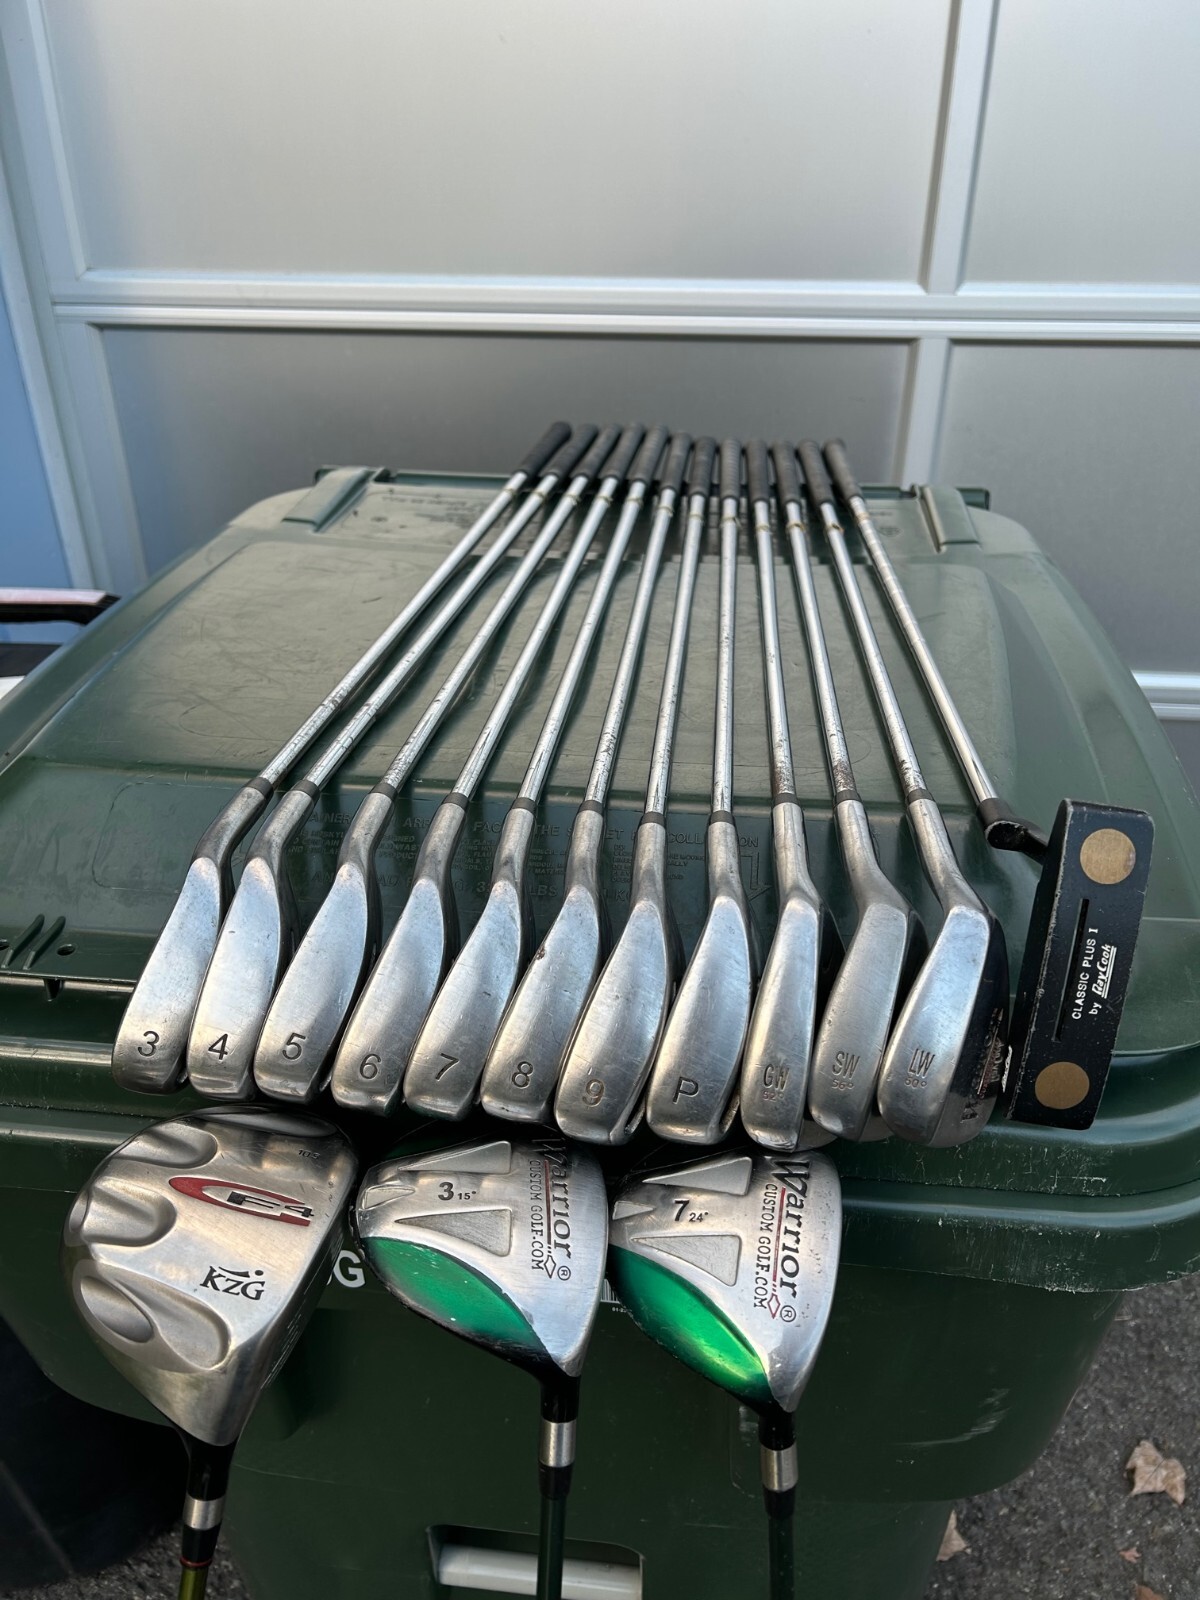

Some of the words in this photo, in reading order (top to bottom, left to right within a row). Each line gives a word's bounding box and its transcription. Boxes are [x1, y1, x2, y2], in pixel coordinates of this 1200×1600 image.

[1071, 971, 1090, 1020] CLASSIC
[1082, 938, 1096, 968] PLUS
[1088, 1002, 1102, 1015] by
[137, 1030, 160, 1057] 3
[207, 1033, 229, 1061] 4
[282, 1032, 307, 1060] 5
[358, 1053, 381, 1080] 6
[433, 1052, 460, 1081] 7
[511, 1060, 535, 1089] 8
[763, 1063, 790, 1091] GW
[831, 1050, 861, 1079] SW
[907, 1048, 936, 1079] LW
[582, 1078, 606, 1108] 9
[672, 1076, 699, 1105] P
[438, 1181, 455, 1201] 3
[529, 1159, 542, 1201] CUSTOM
[532, 1138, 572, 1260] Warrior
[673, 1199, 690, 1222] 7
[759, 1183, 779, 1233] CUSTOM
[530, 1206, 545, 1271] GOLF.COM
[768, 1157, 811, 1299] Warrior
[200, 1265, 266, 1301] KZG
[753, 1236, 772, 1309] GOLF.COM
